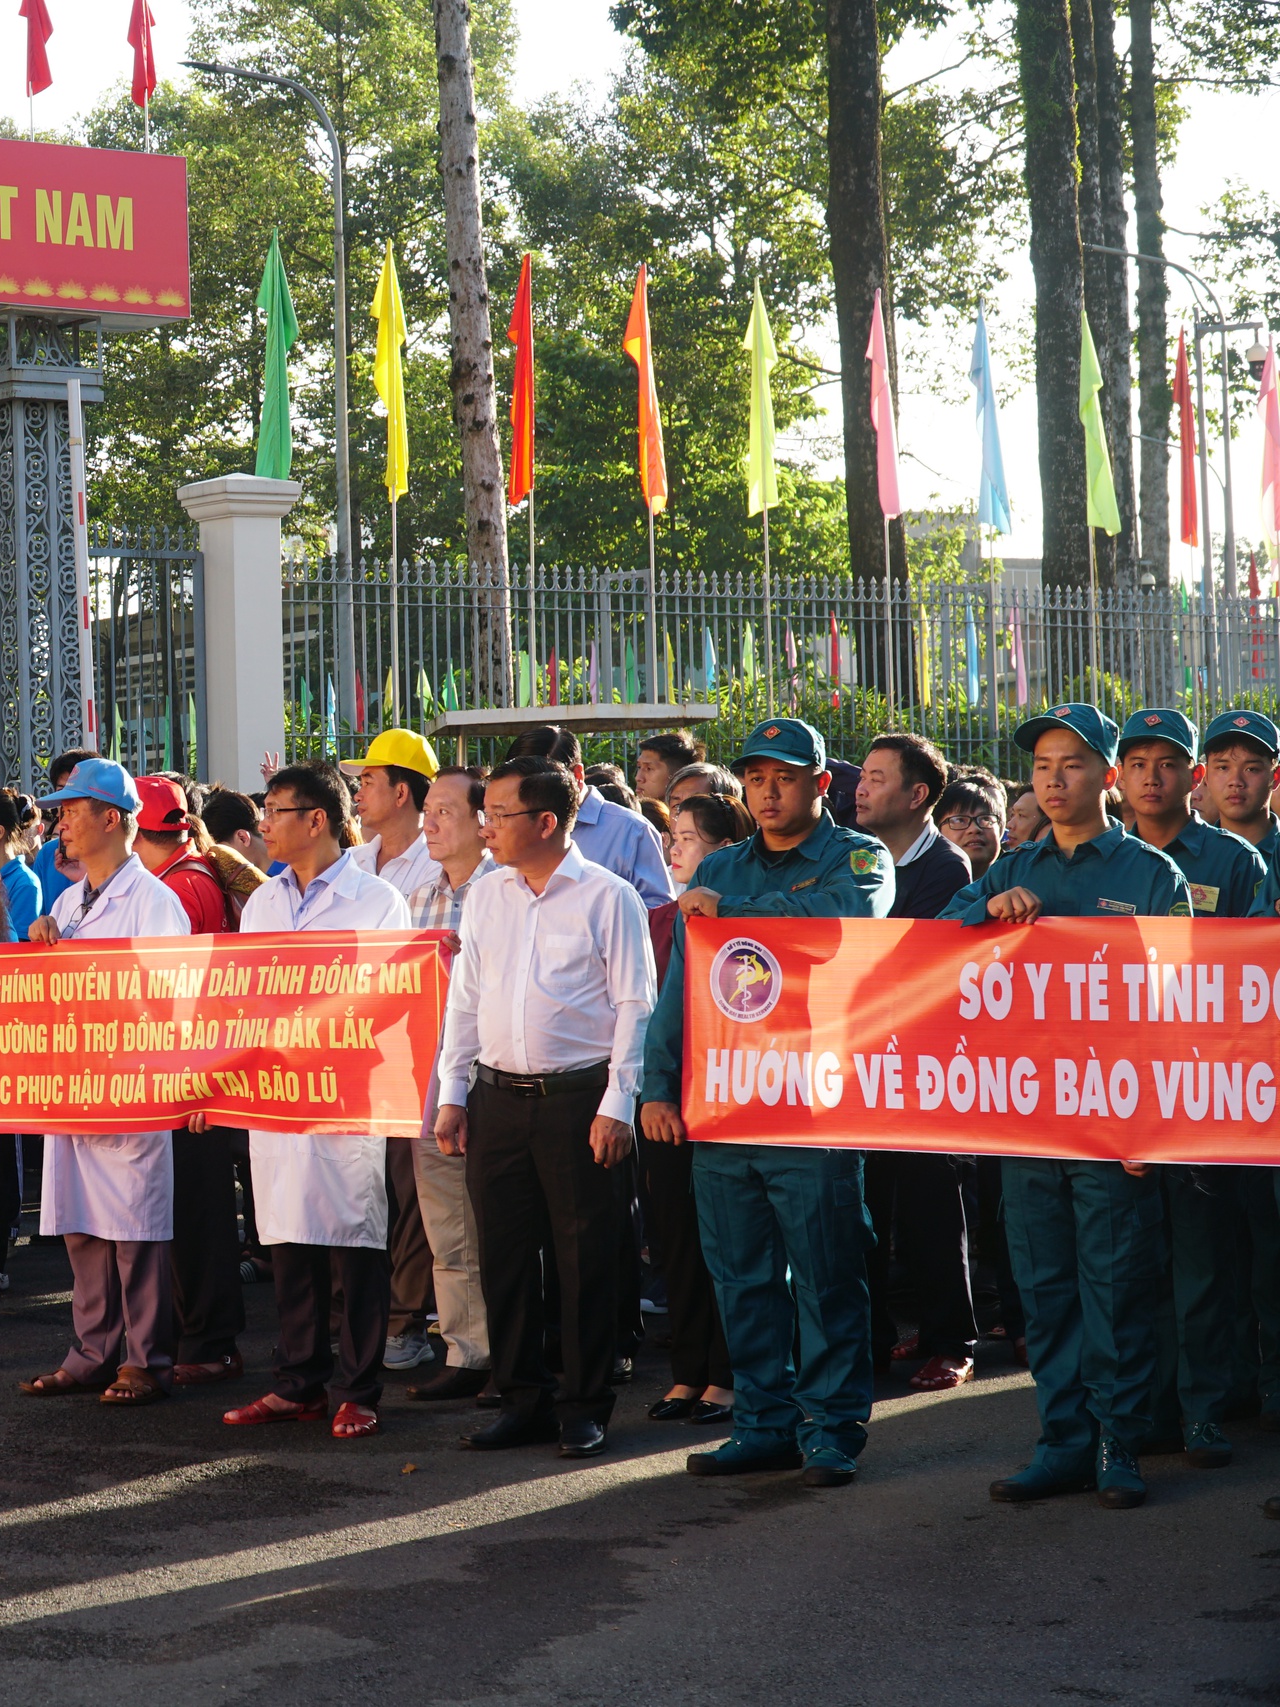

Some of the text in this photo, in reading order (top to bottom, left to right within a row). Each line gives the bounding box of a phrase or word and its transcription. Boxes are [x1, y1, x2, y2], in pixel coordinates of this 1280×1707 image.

[35, 188, 134, 251] NAM
[49, 958, 112, 1004] QUYỀN
[116, 961, 143, 1000] VÀ
[146, 960, 205, 1001] NHÂN
[207, 960, 251, 998] DÂN
[254, 954, 307, 996] TỈNH
[309, 953, 371, 995] ĐỒNG
[378, 962, 422, 995] NAI
[958, 943, 1280, 1023] SỞ Y TẾ TỈNH Đ
[52, 1010, 78, 1054] HỖ
[82, 1017, 119, 1059] TRỢ
[122, 1013, 175, 1053] ĐỒNG
[180, 1013, 218, 1051] BÀO
[224, 1010, 269, 1050] TỈNH
[273, 1005, 321, 1050] ĐẮK
[328, 1005, 376, 1050] LẮK
[16, 1073, 63, 1111] PHỤC
[68, 1067, 106, 1111] HẬU
[109, 1063, 147, 1107] QUẢ
[151, 1067, 211, 1103] THIÊN
[212, 1071, 255, 1103] TAI,
[257, 1064, 300, 1103] BÃO
[307, 1064, 338, 1103] LŨ
[705, 1034, 1277, 1123] HƯỚNG VỀ ĐỒNG BÀO VÙNG
